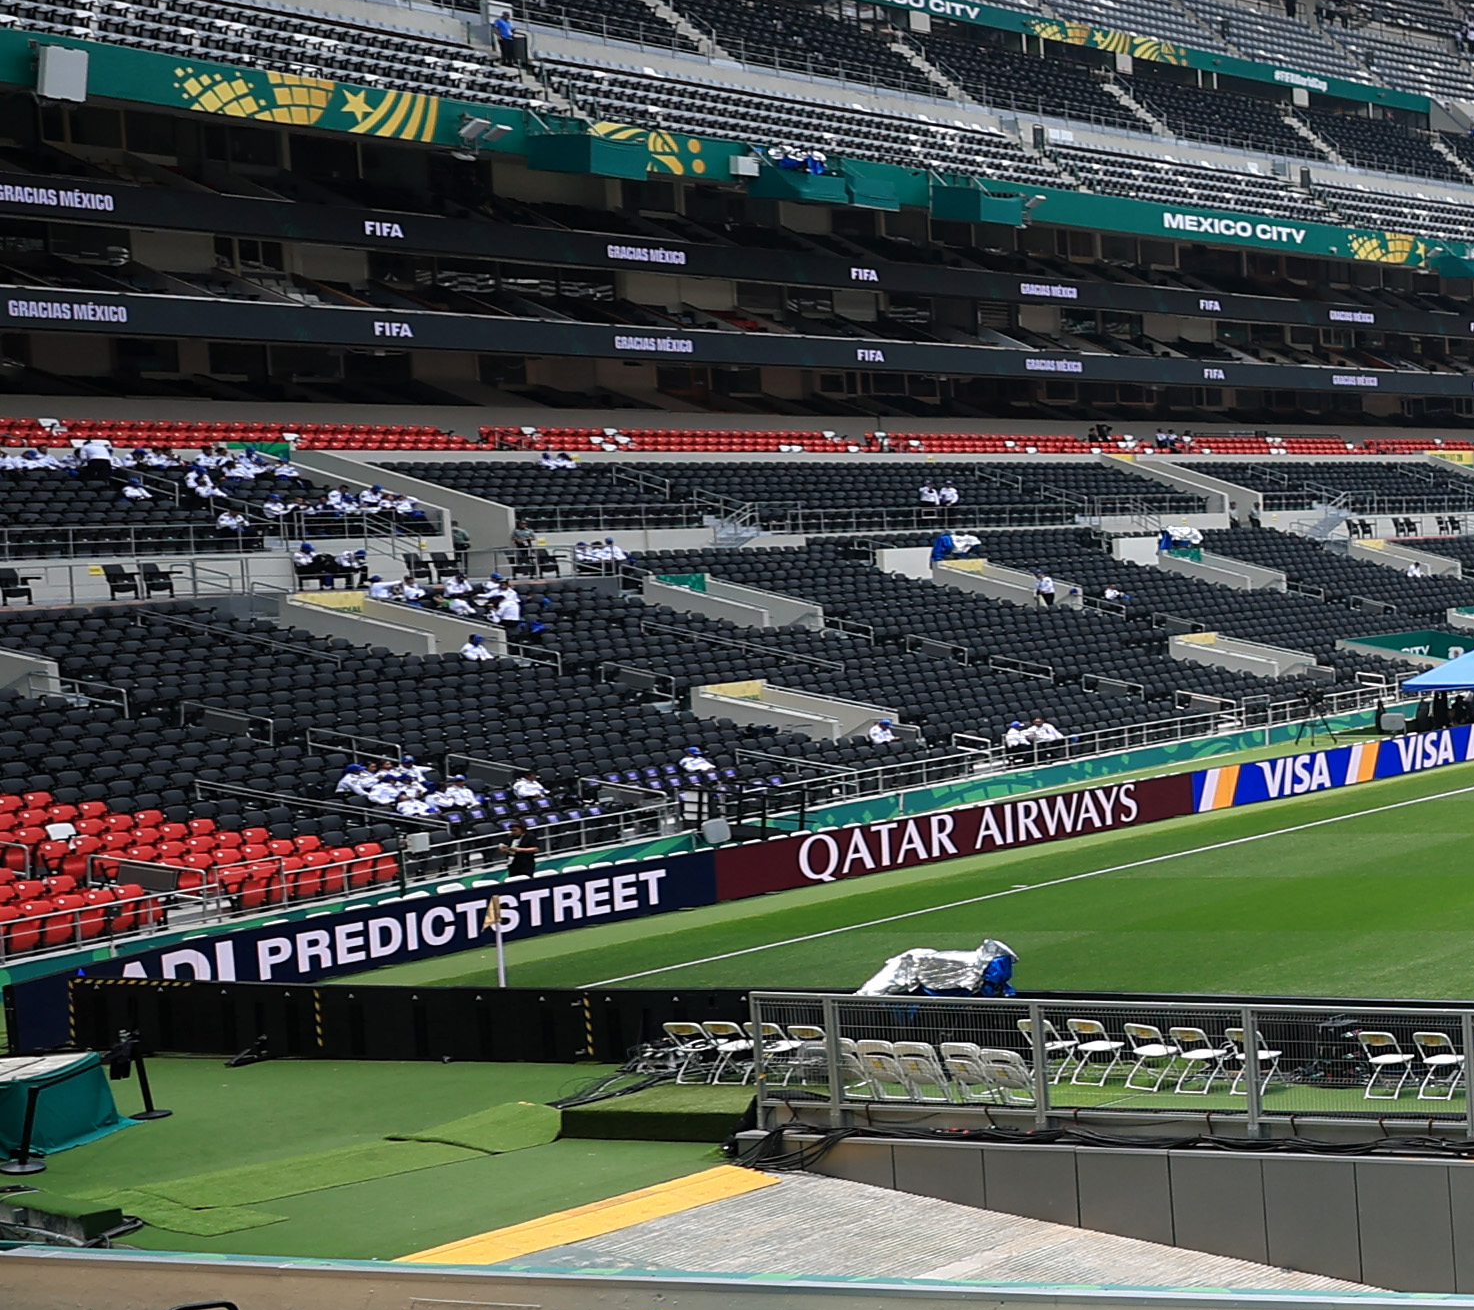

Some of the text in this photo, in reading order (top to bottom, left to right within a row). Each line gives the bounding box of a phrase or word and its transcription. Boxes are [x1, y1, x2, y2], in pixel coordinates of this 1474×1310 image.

[59, 188, 114, 211] MÉXICO
[364, 221, 404, 238] FIFA
[1163, 212, 1306, 245] MEXICO CITY
[851, 267, 880, 282] FIFA
[8, 299, 128, 322] GRACIAS MÉXICO
[1199, 299, 1221, 312] FIFA
[374, 321, 413, 337] FIFA
[857, 348, 885, 362] FIFA
[1204, 368, 1225, 380] FIFA
[1394, 729, 1456, 773] VISA
[1255, 750, 1333, 799] VISA
[798, 783, 1140, 882] QATAR AIRWAYS
[257, 868, 669, 982] PREDICTSTREET
